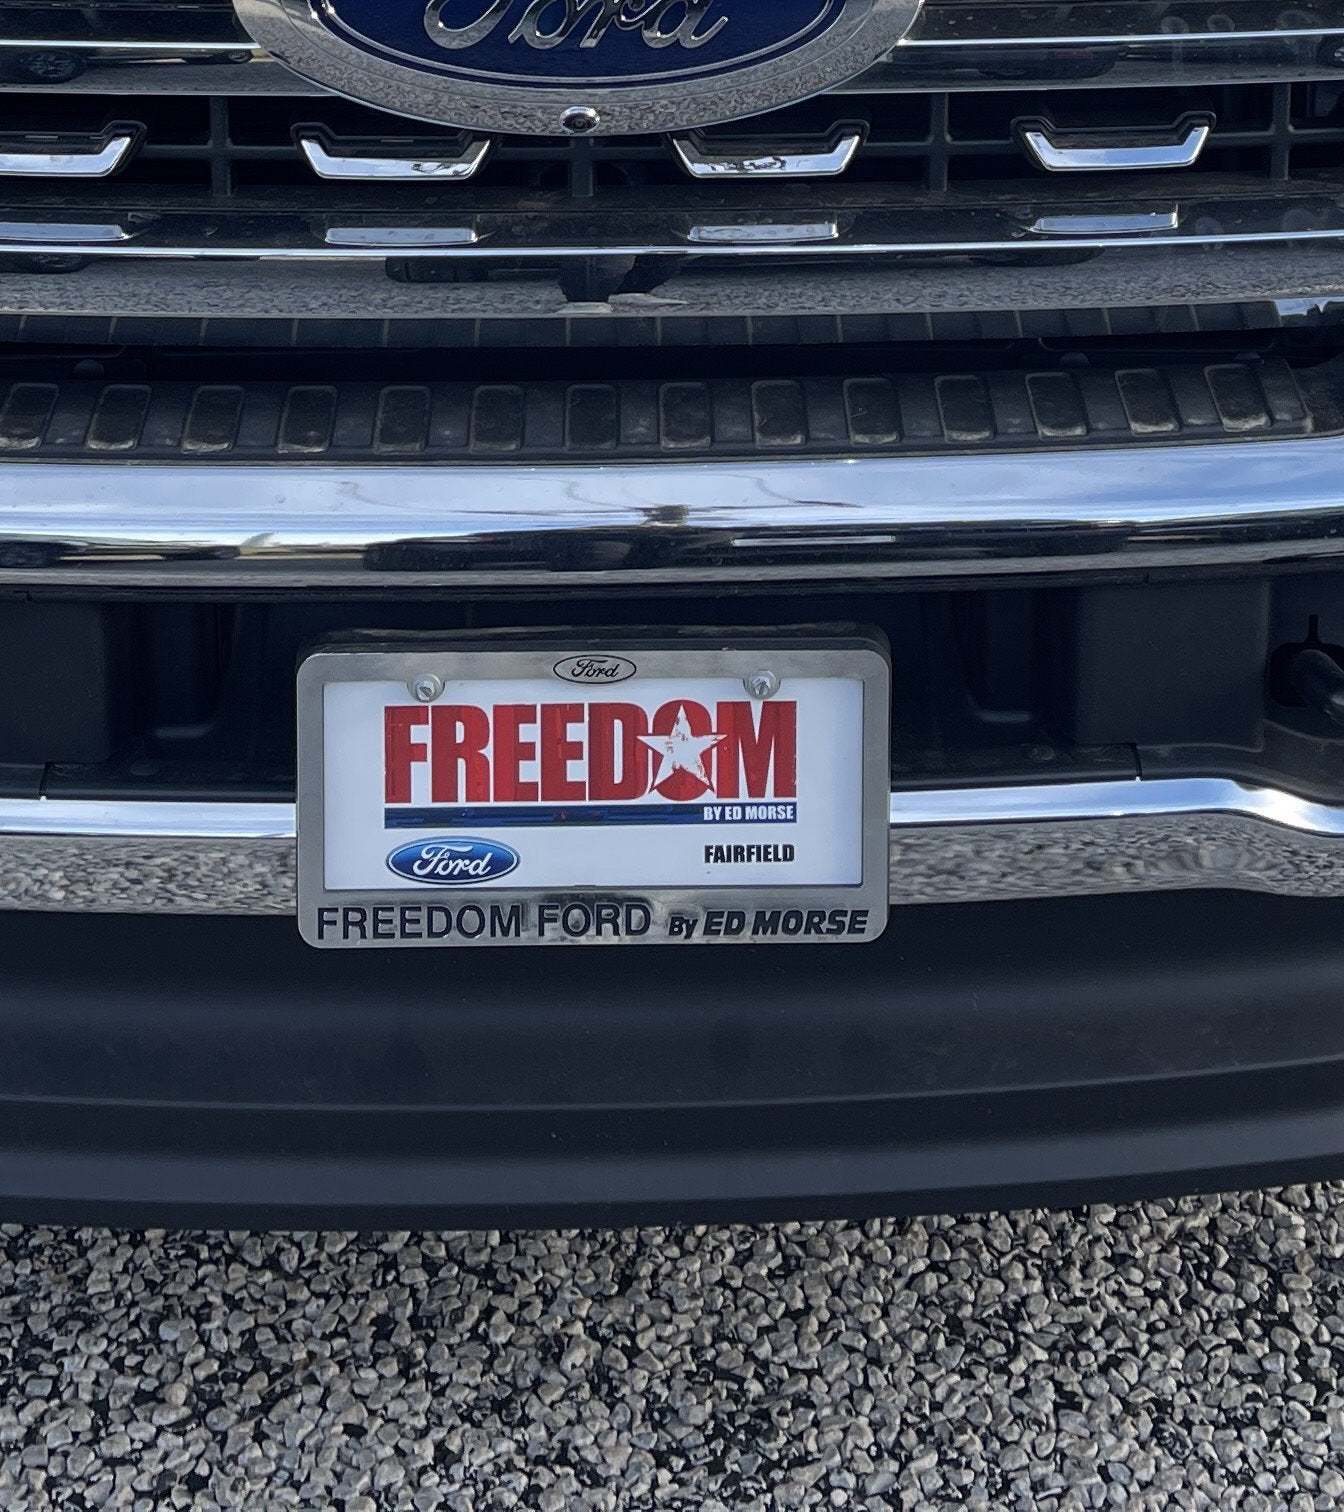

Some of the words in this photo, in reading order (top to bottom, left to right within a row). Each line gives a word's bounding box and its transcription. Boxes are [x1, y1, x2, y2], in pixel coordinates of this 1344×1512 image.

[570, 658, 620, 679] Ford
[384, 699, 798, 803] FREEDOM
[703, 806, 722, 822] BY
[725, 806, 743, 821] ED
[746, 805, 795, 821] MORSE
[412, 842, 492, 876] Ford
[703, 844, 796, 863] FAIRFIELD
[317, 906, 521, 940] FREEDOM
[537, 903, 652, 937] FORD
[703, 911, 746, 936] ED
[752, 909, 870, 935] MORSE
